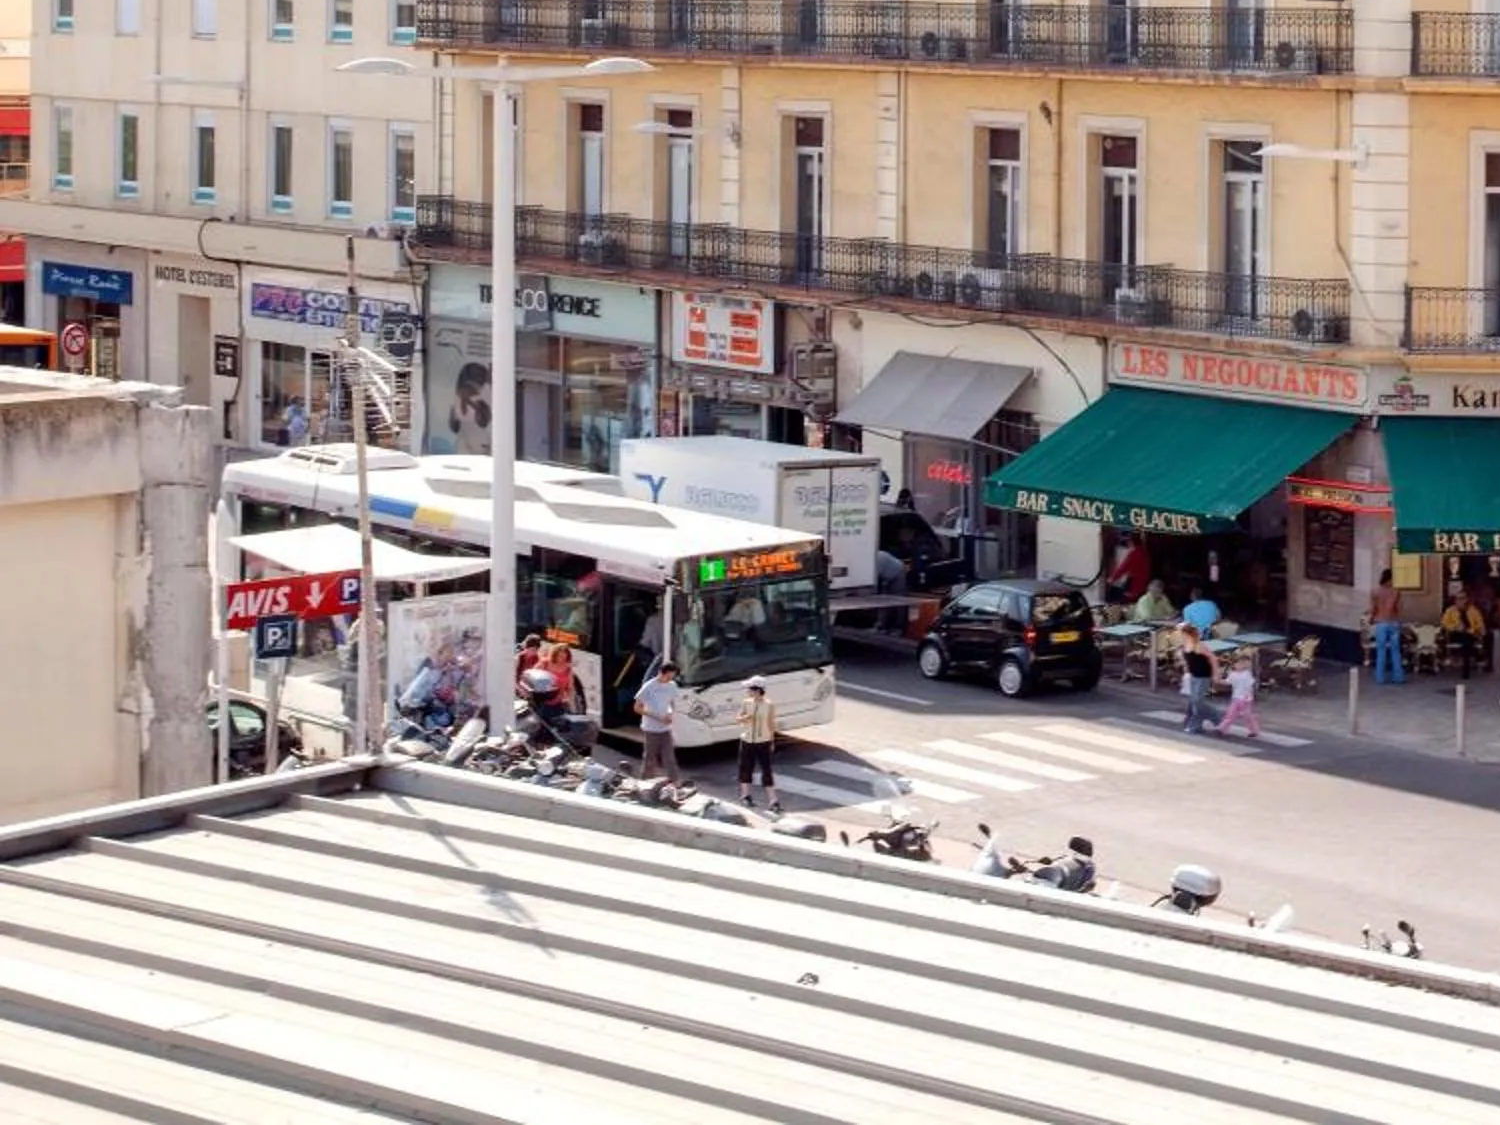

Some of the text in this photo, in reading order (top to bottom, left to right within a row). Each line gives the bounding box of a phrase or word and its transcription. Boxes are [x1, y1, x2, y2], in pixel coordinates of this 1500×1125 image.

[155, 265, 187, 284] HOTEL
[1120, 345, 1359, 401] LES NEGOCIANTS
[1016, 490, 1048, 512] BAR
[1062, 496, 1115, 523] SNACK
[1130, 508, 1201, 534] GLACIER
[1434, 532, 1480, 552] BAR
[227, 578, 359, 620] AVIS P
[267, 629, 281, 648] P
